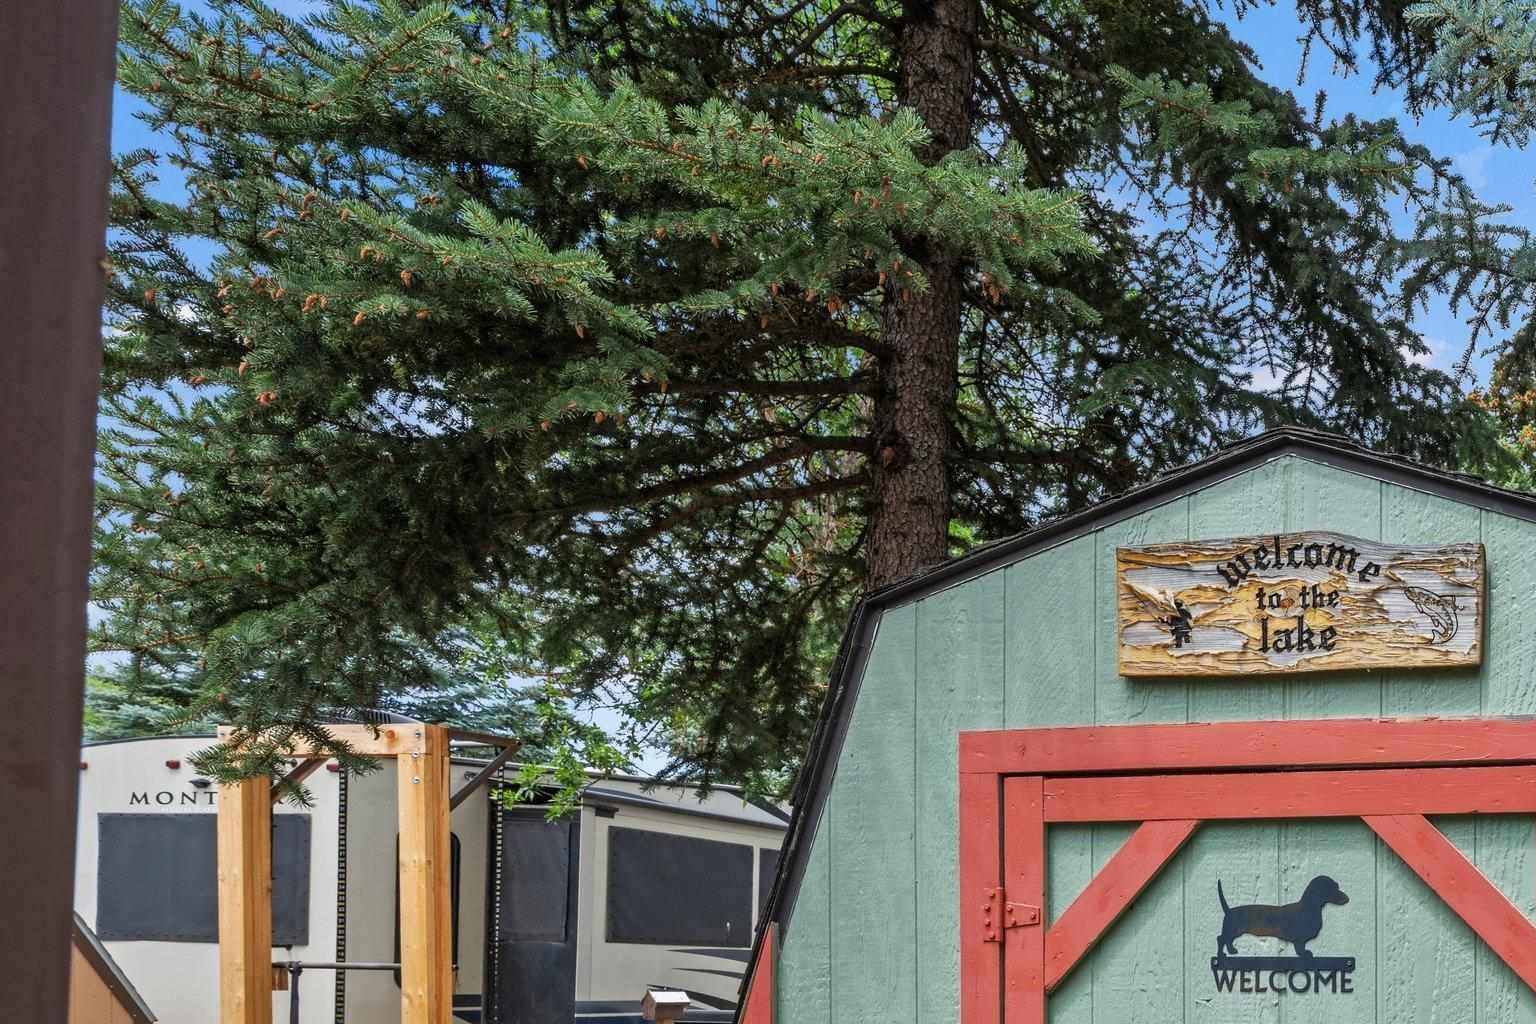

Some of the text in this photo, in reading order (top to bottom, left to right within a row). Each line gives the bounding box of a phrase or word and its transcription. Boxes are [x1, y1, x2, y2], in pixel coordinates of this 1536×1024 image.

[1256, 584, 1340, 610] to the
[1259, 615, 1337, 653] lake
[1214, 970, 1354, 993] WELCOME
